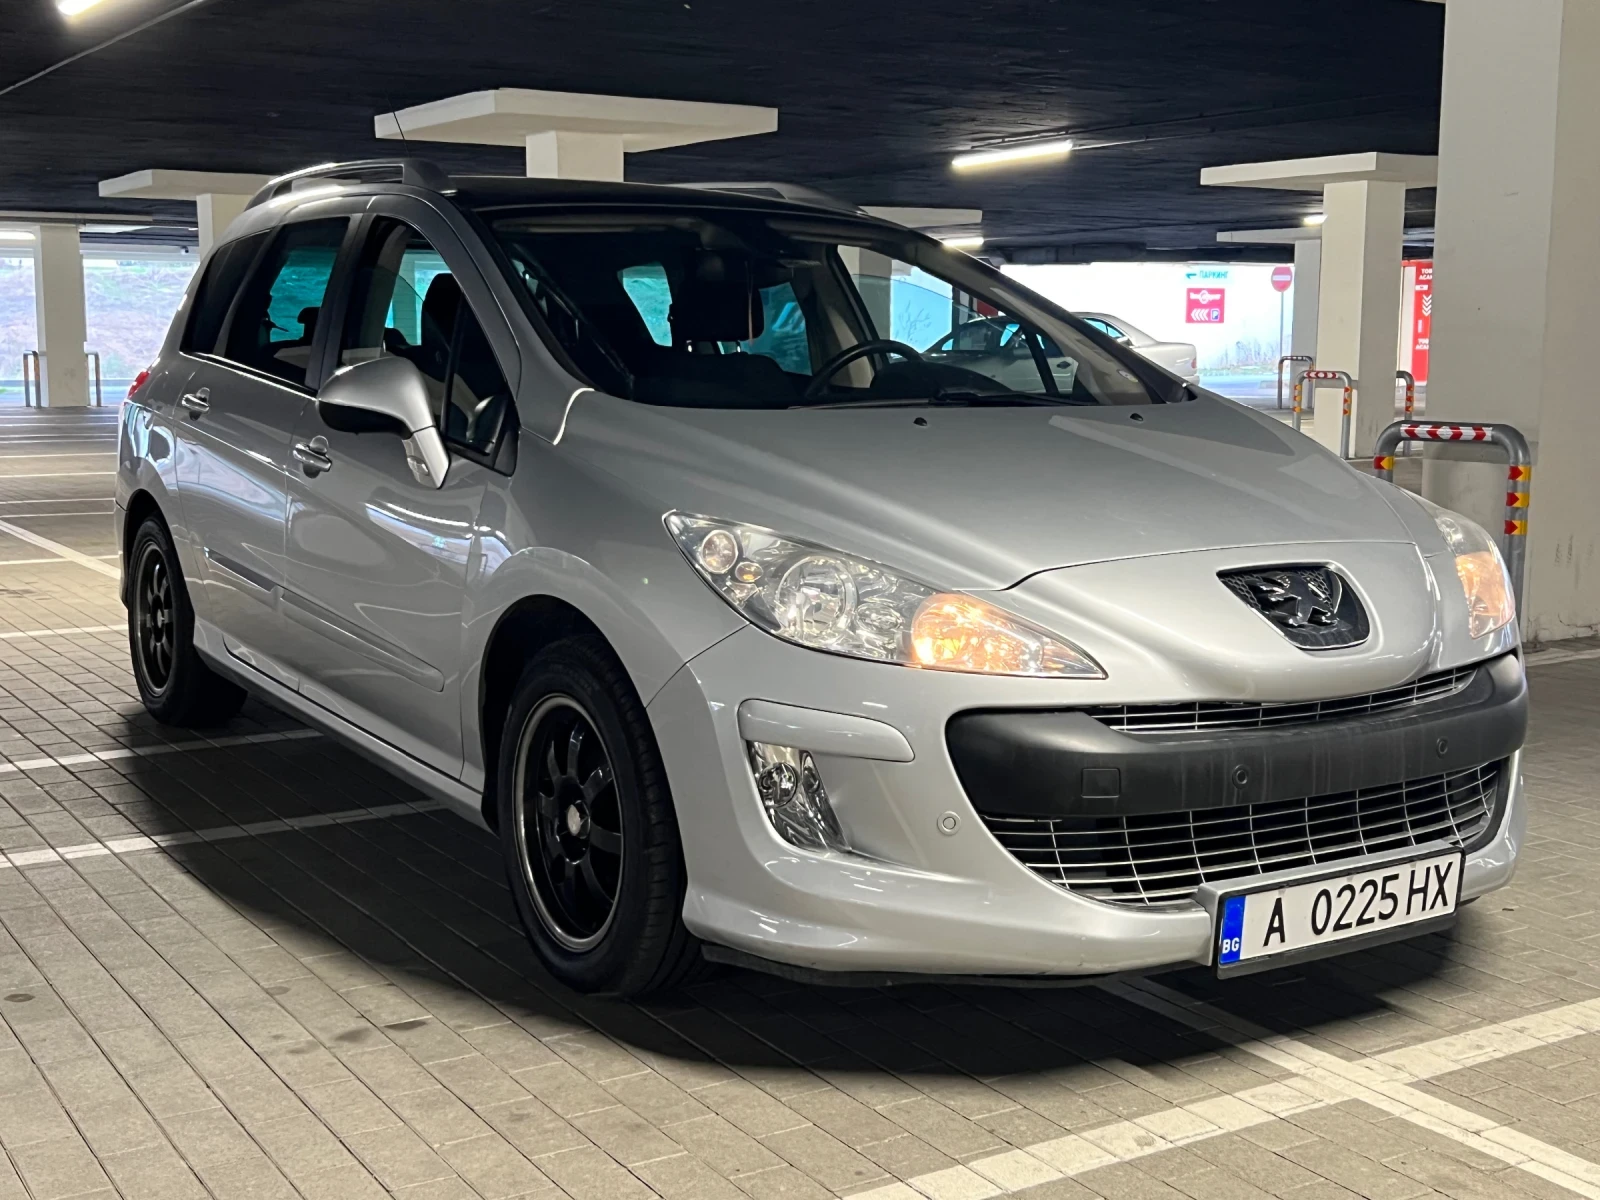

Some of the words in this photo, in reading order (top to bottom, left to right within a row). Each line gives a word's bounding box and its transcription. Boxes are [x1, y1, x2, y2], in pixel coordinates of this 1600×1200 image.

[1200, 270, 1228, 279] ПАРКИНГ
[1263, 897, 1286, 946] A
[1311, 873, 1400, 935] 0225
[1406, 862, 1453, 915] HX
[1222, 938, 1240, 953] BG
